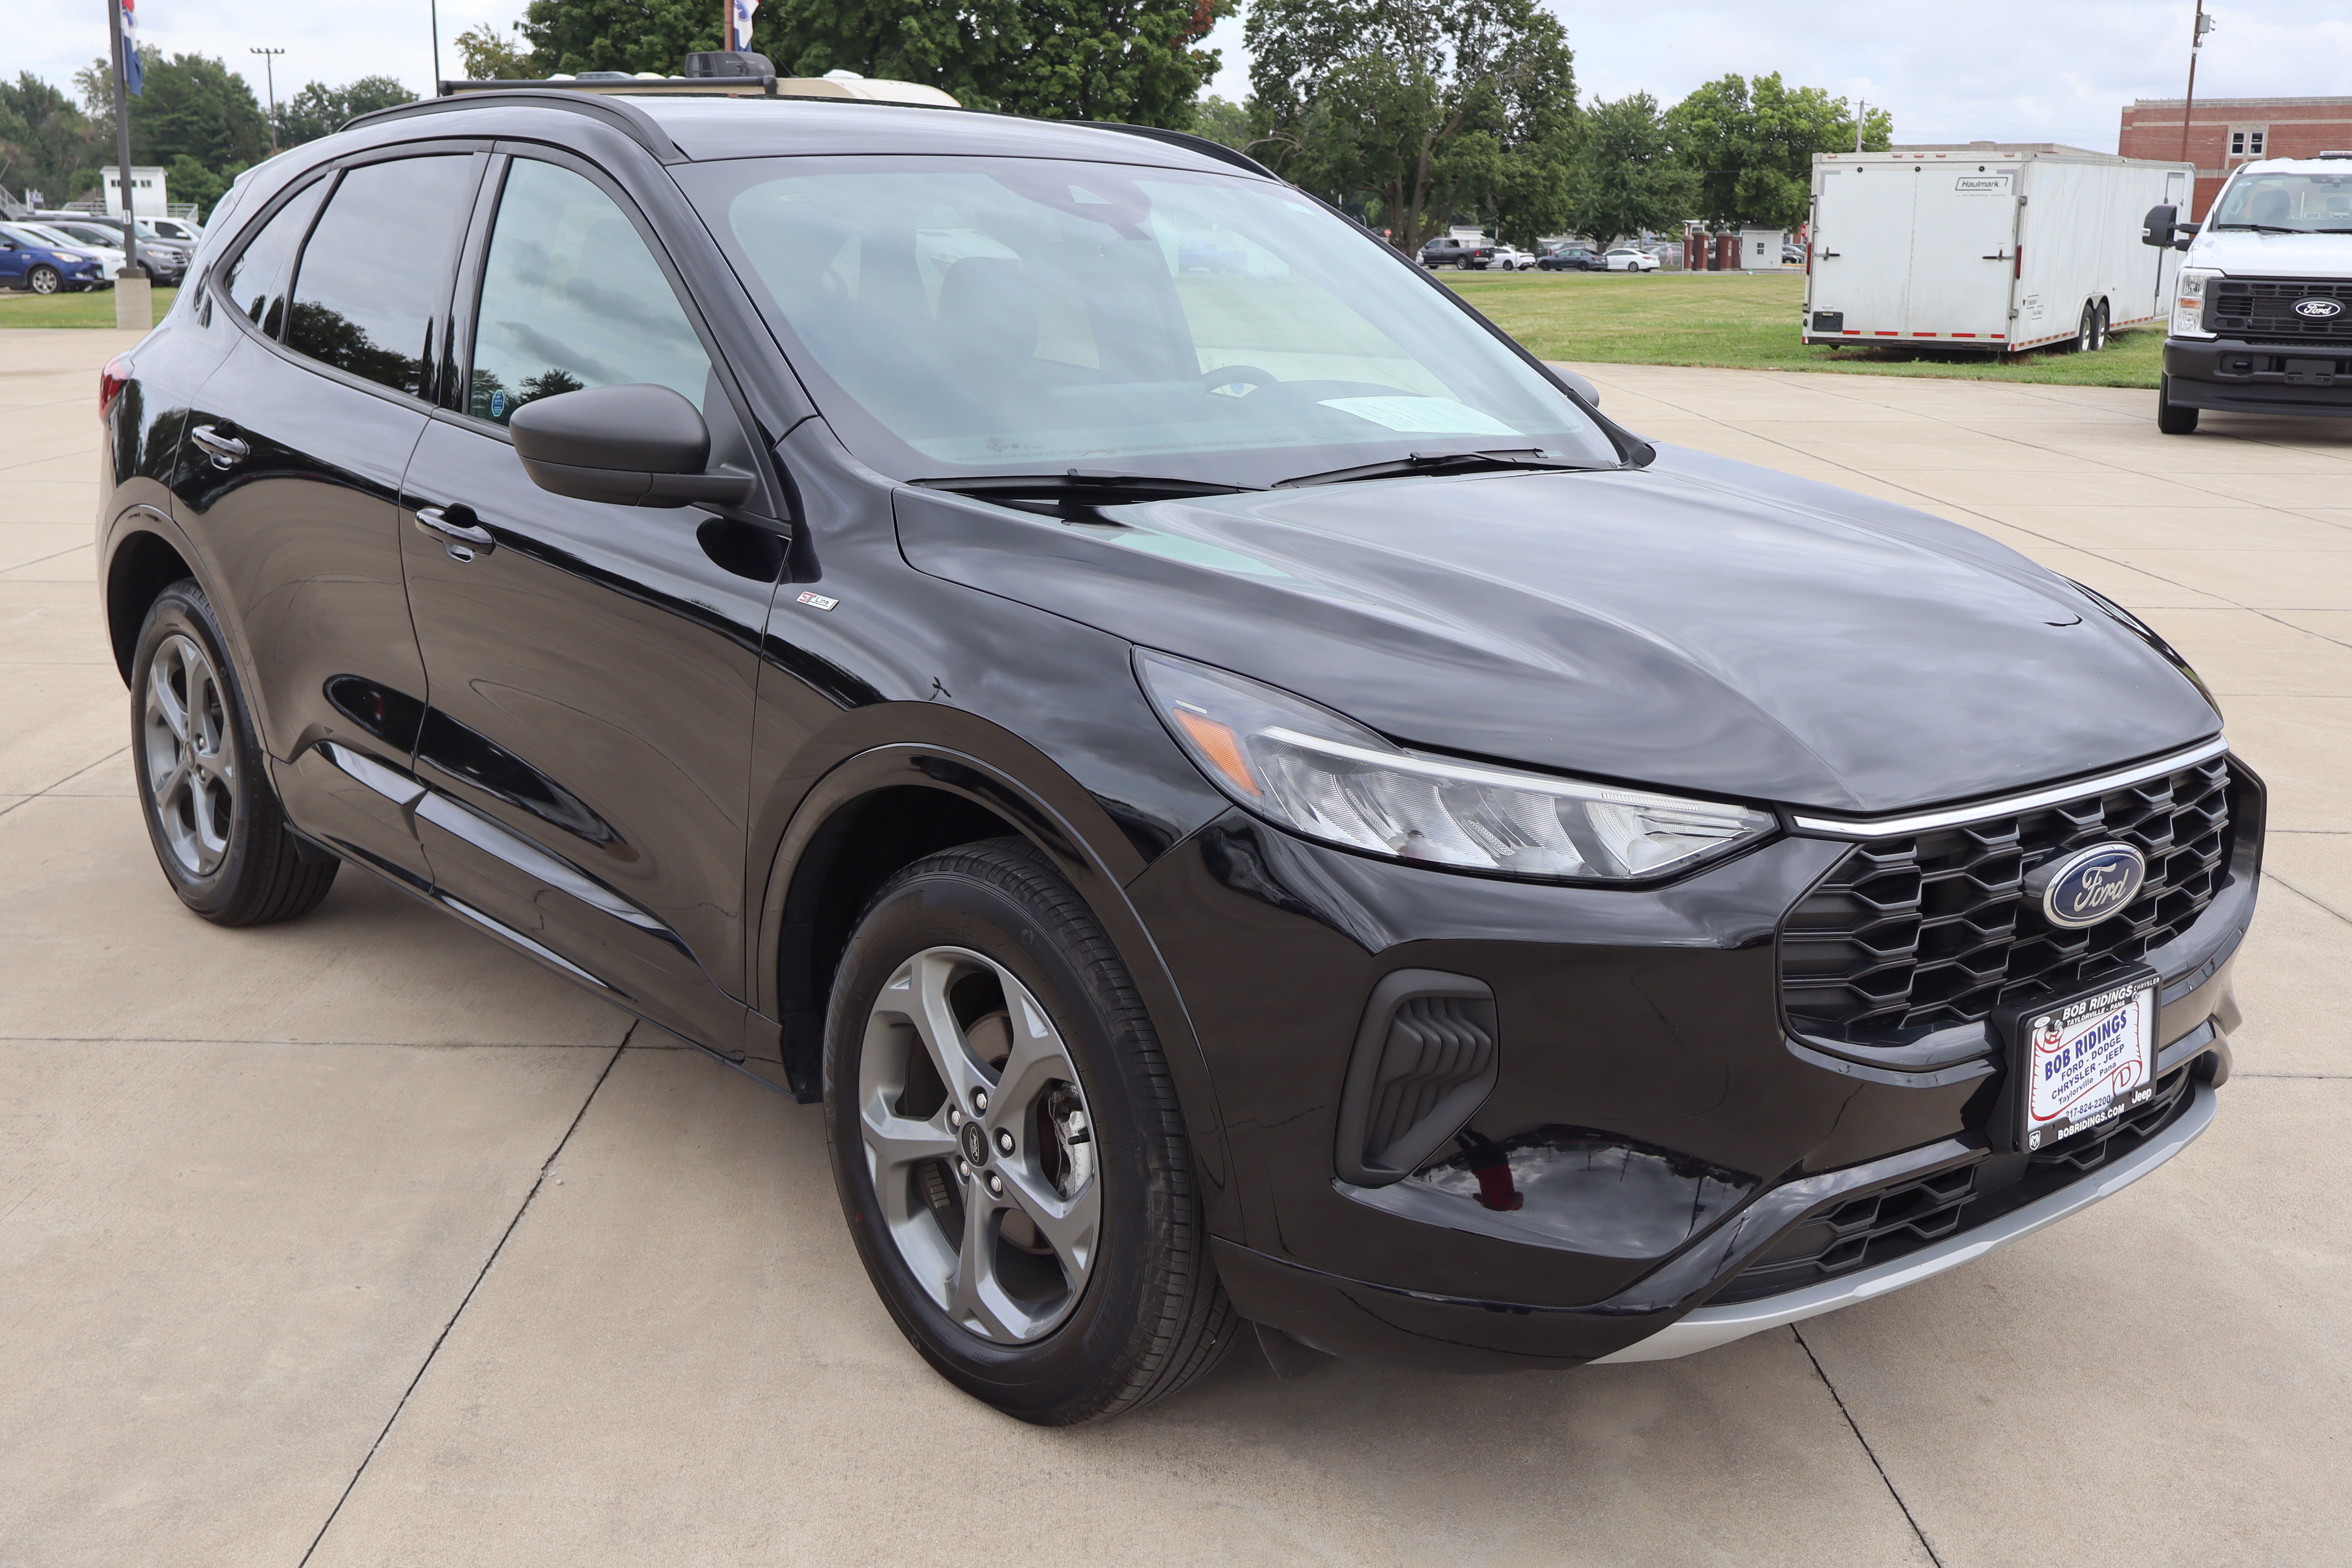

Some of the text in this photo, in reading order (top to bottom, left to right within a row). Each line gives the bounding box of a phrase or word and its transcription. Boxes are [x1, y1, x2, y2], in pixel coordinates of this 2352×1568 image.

[2303, 303, 2332, 314] Ford
[799, 592, 817, 603] ST
[2074, 862, 2129, 912] Ford
[2062, 977, 2160, 1021] BOB RIDINGS CHRYSLER
[2066, 1007, 2105, 1027] TAYLORVILLE
[2110, 1000, 2125, 1011] PANA
[2045, 1009, 2127, 1081] BOB RIDINGS
[2061, 1059, 2084, 1081] FORD
[2091, 1033, 2121, 1060] DODGE
[2051, 1062, 2096, 1100] CHRYSLER
[2103, 1043, 2124, 1064] JEEP
[2058, 1062, 2116, 1105] Taylorville Pana
[2065, 1095, 2111, 1118] 217-824-2200
[2132, 1088, 2152, 1104] Jeep
[2058, 1103, 2125, 1140] BOBRIDINGS.COM
